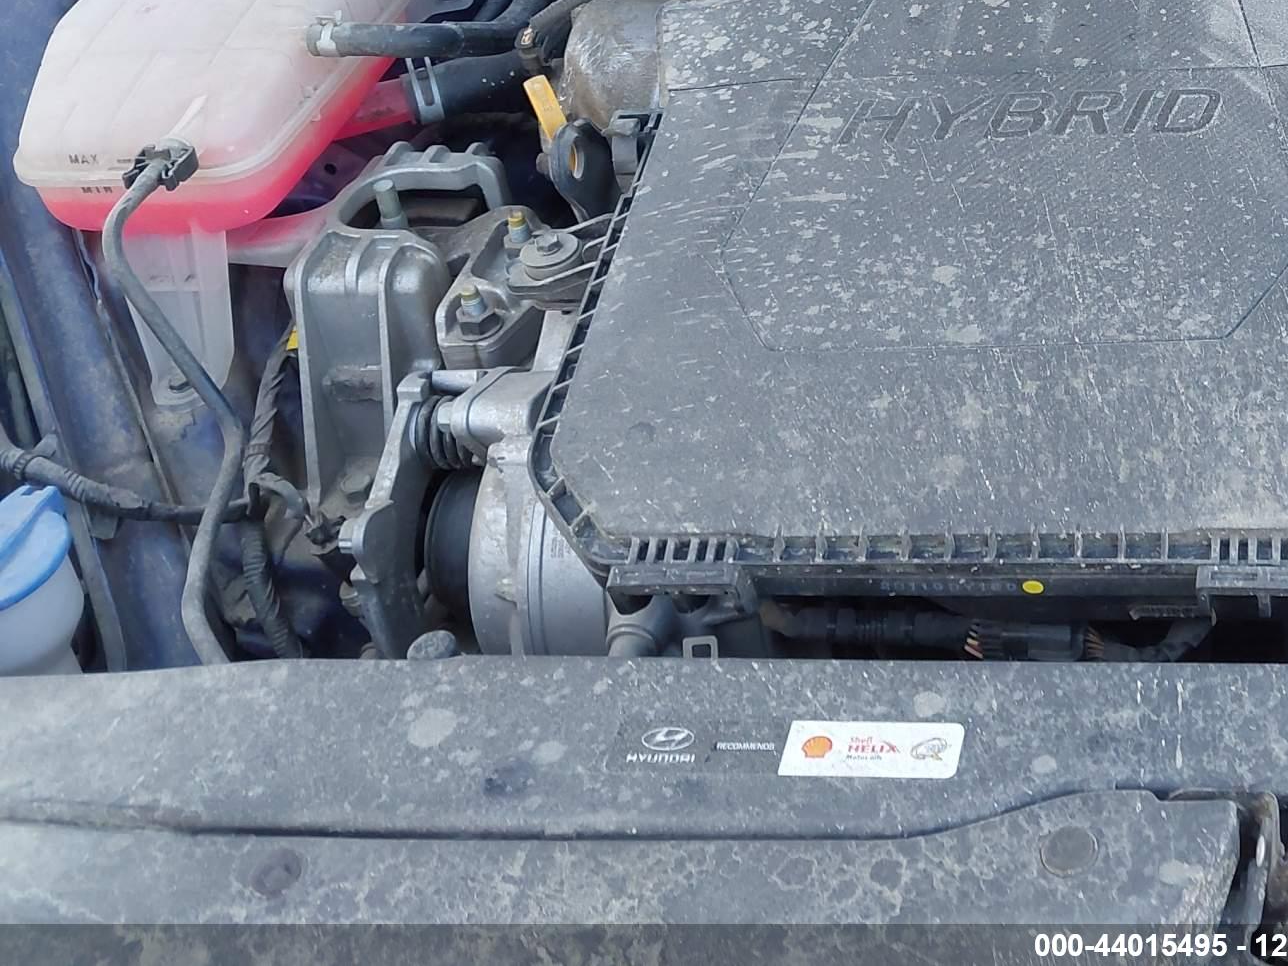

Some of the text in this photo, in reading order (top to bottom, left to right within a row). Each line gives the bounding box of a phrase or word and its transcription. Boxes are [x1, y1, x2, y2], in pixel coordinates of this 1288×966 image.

[834, 88, 1223, 148] HYBRID
[69, 154, 98, 164] MAX
[81, 186, 113, 194] MIN
[626, 741, 775, 764] HYUNDAI RECOMMENDS
[848, 743, 898, 754] HELIX
